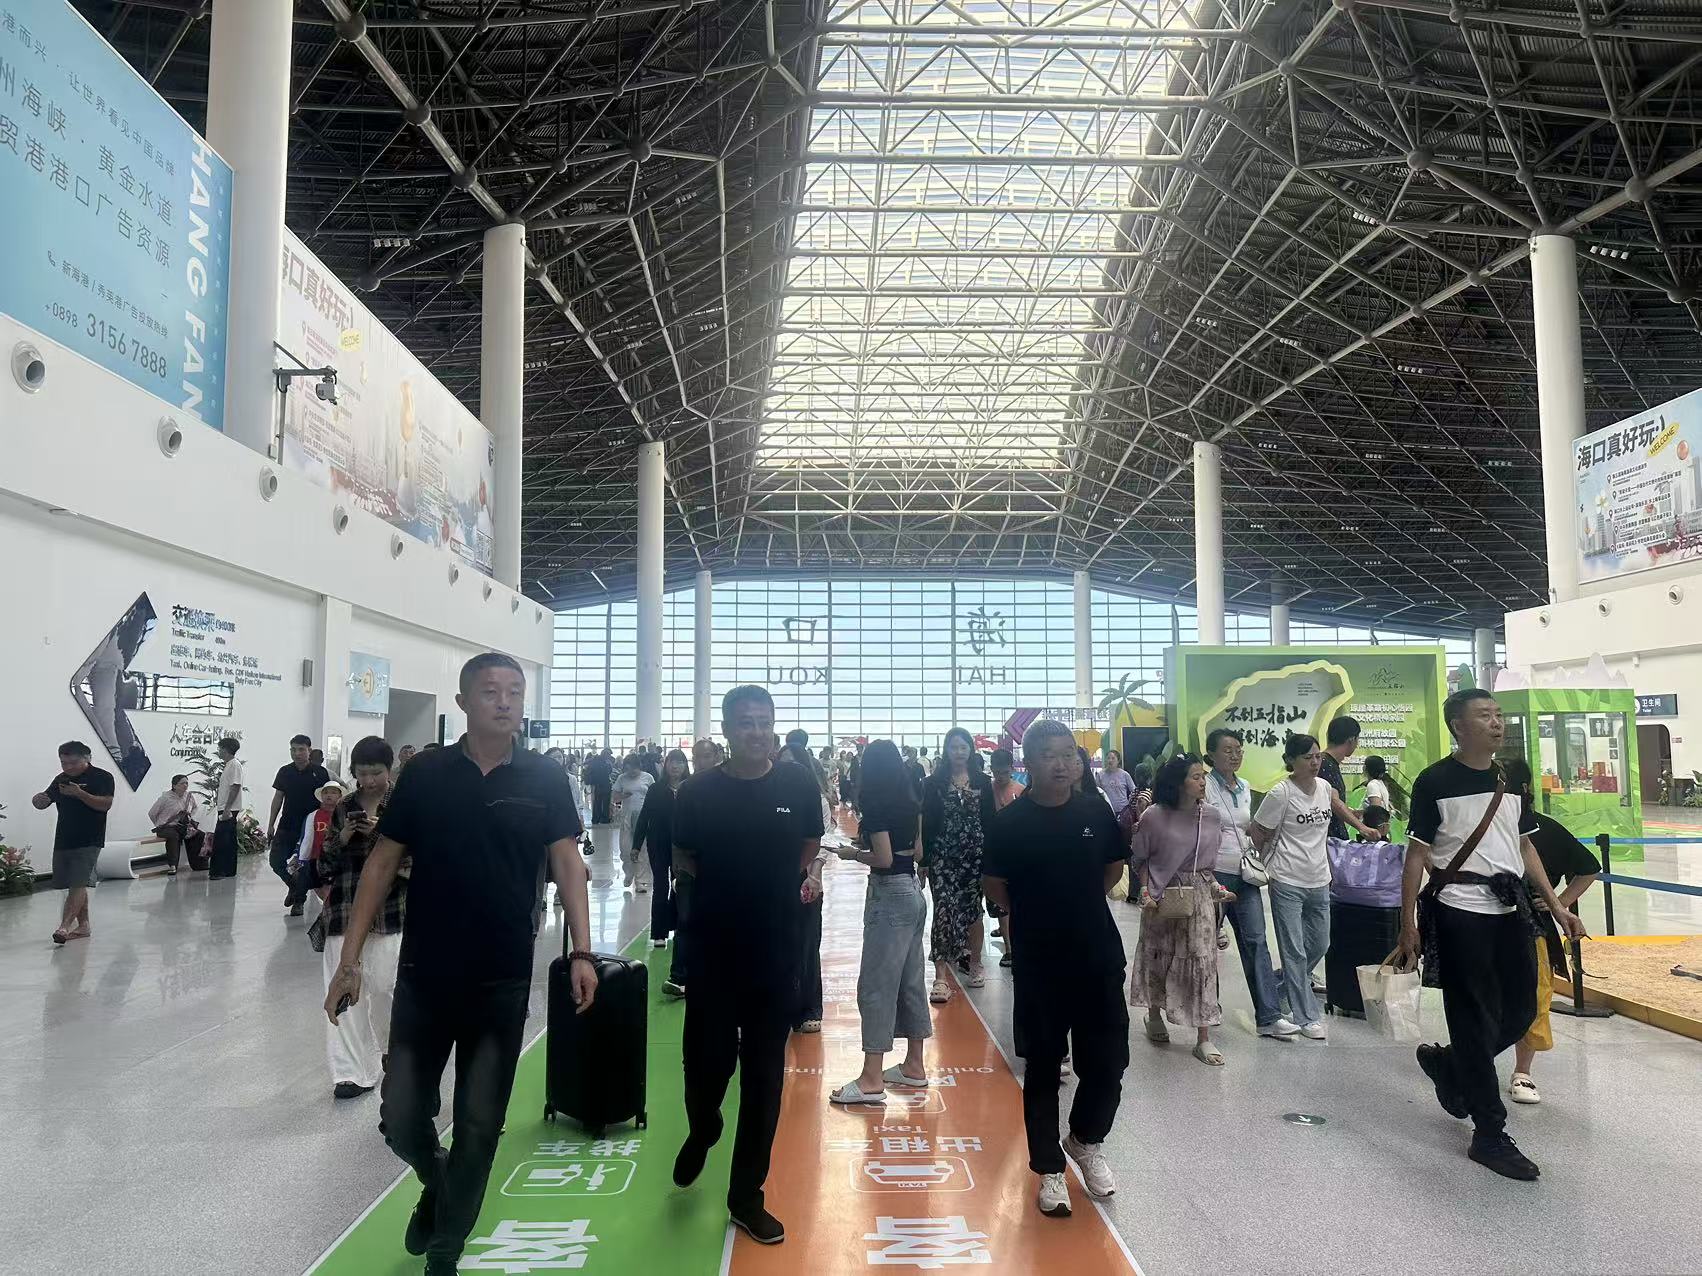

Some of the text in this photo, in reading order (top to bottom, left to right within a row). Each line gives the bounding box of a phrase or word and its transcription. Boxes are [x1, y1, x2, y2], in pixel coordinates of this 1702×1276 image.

[98, 144, 173, 227] 黄金水道
[187, 136, 213, 298] HANG
[1649, 425, 1675, 455] WELCOME
[1225, 703, 1308, 725] 不到五指山
[1642, 698, 1661, 707] 卫生间
[873, 1125, 928, 1134] Taxi
[533, 1138, 642, 1157] 找车
[825, 1135, 983, 1153] 出租车
[456, 1217, 599, 1273] 客
[863, 1215, 993, 1269] 客
